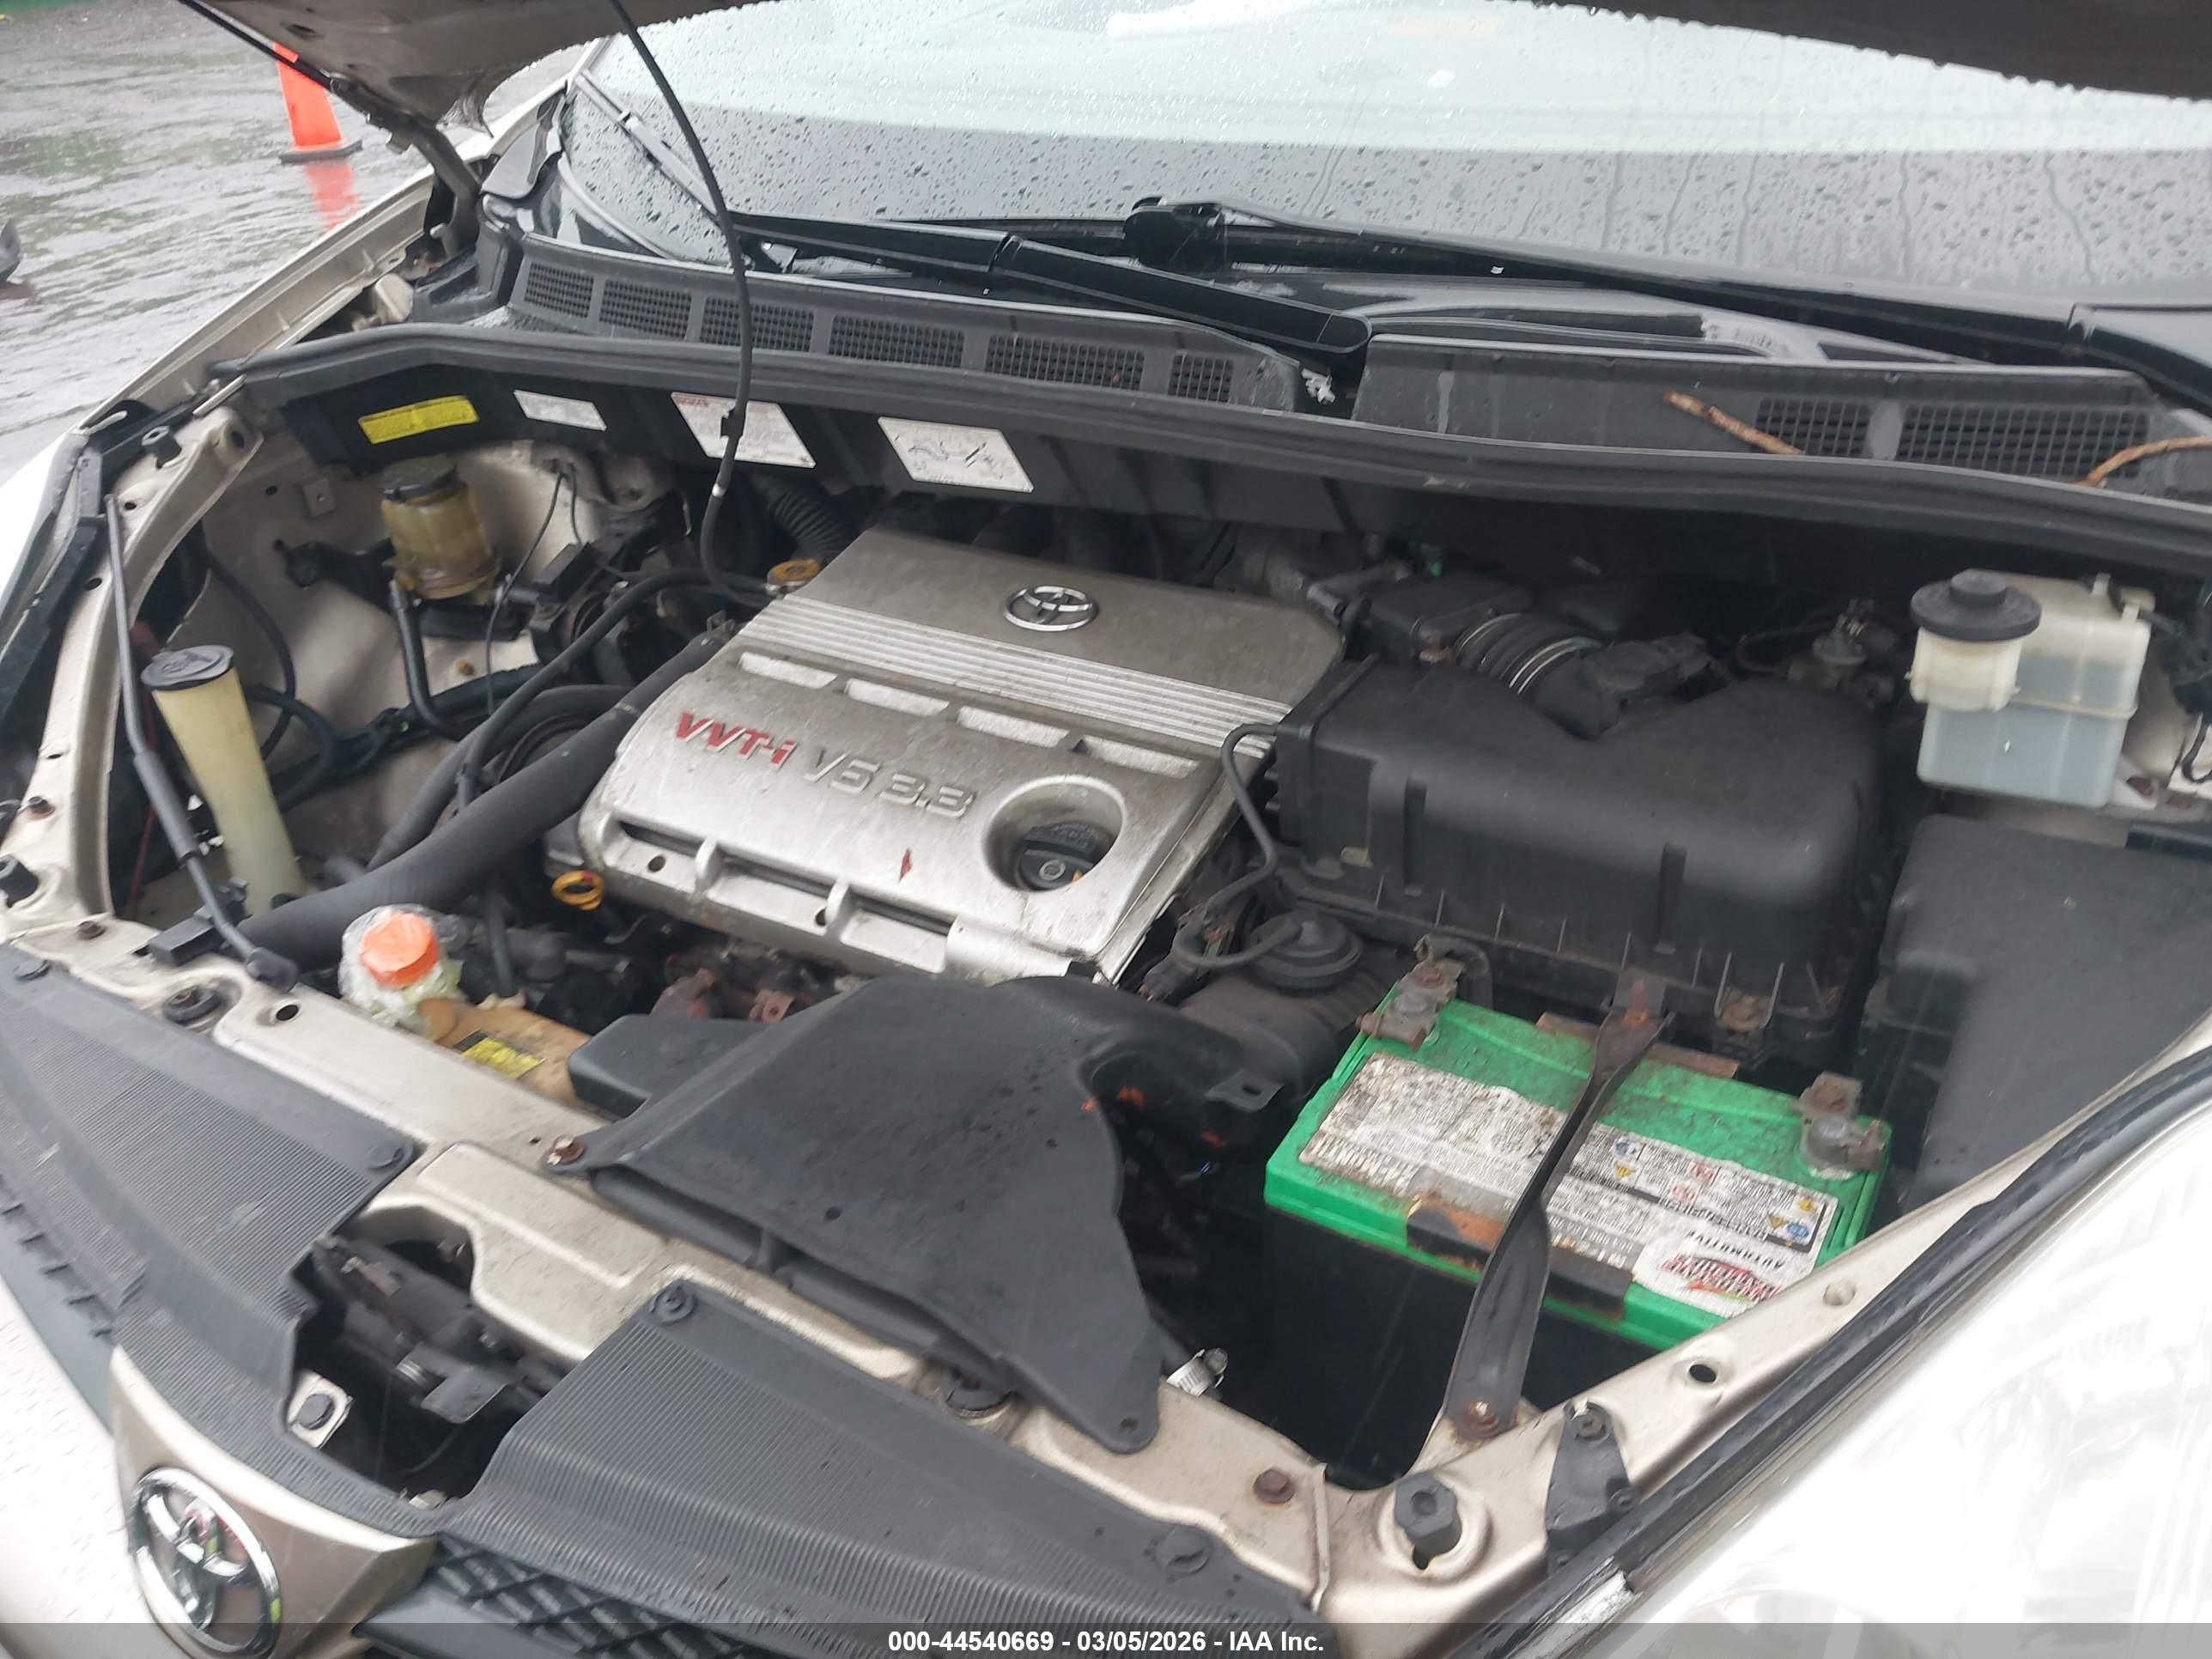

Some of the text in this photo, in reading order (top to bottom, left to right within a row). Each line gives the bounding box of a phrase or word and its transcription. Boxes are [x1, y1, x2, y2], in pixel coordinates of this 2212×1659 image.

[675, 712, 977, 818] VVT-i V6 3.3
